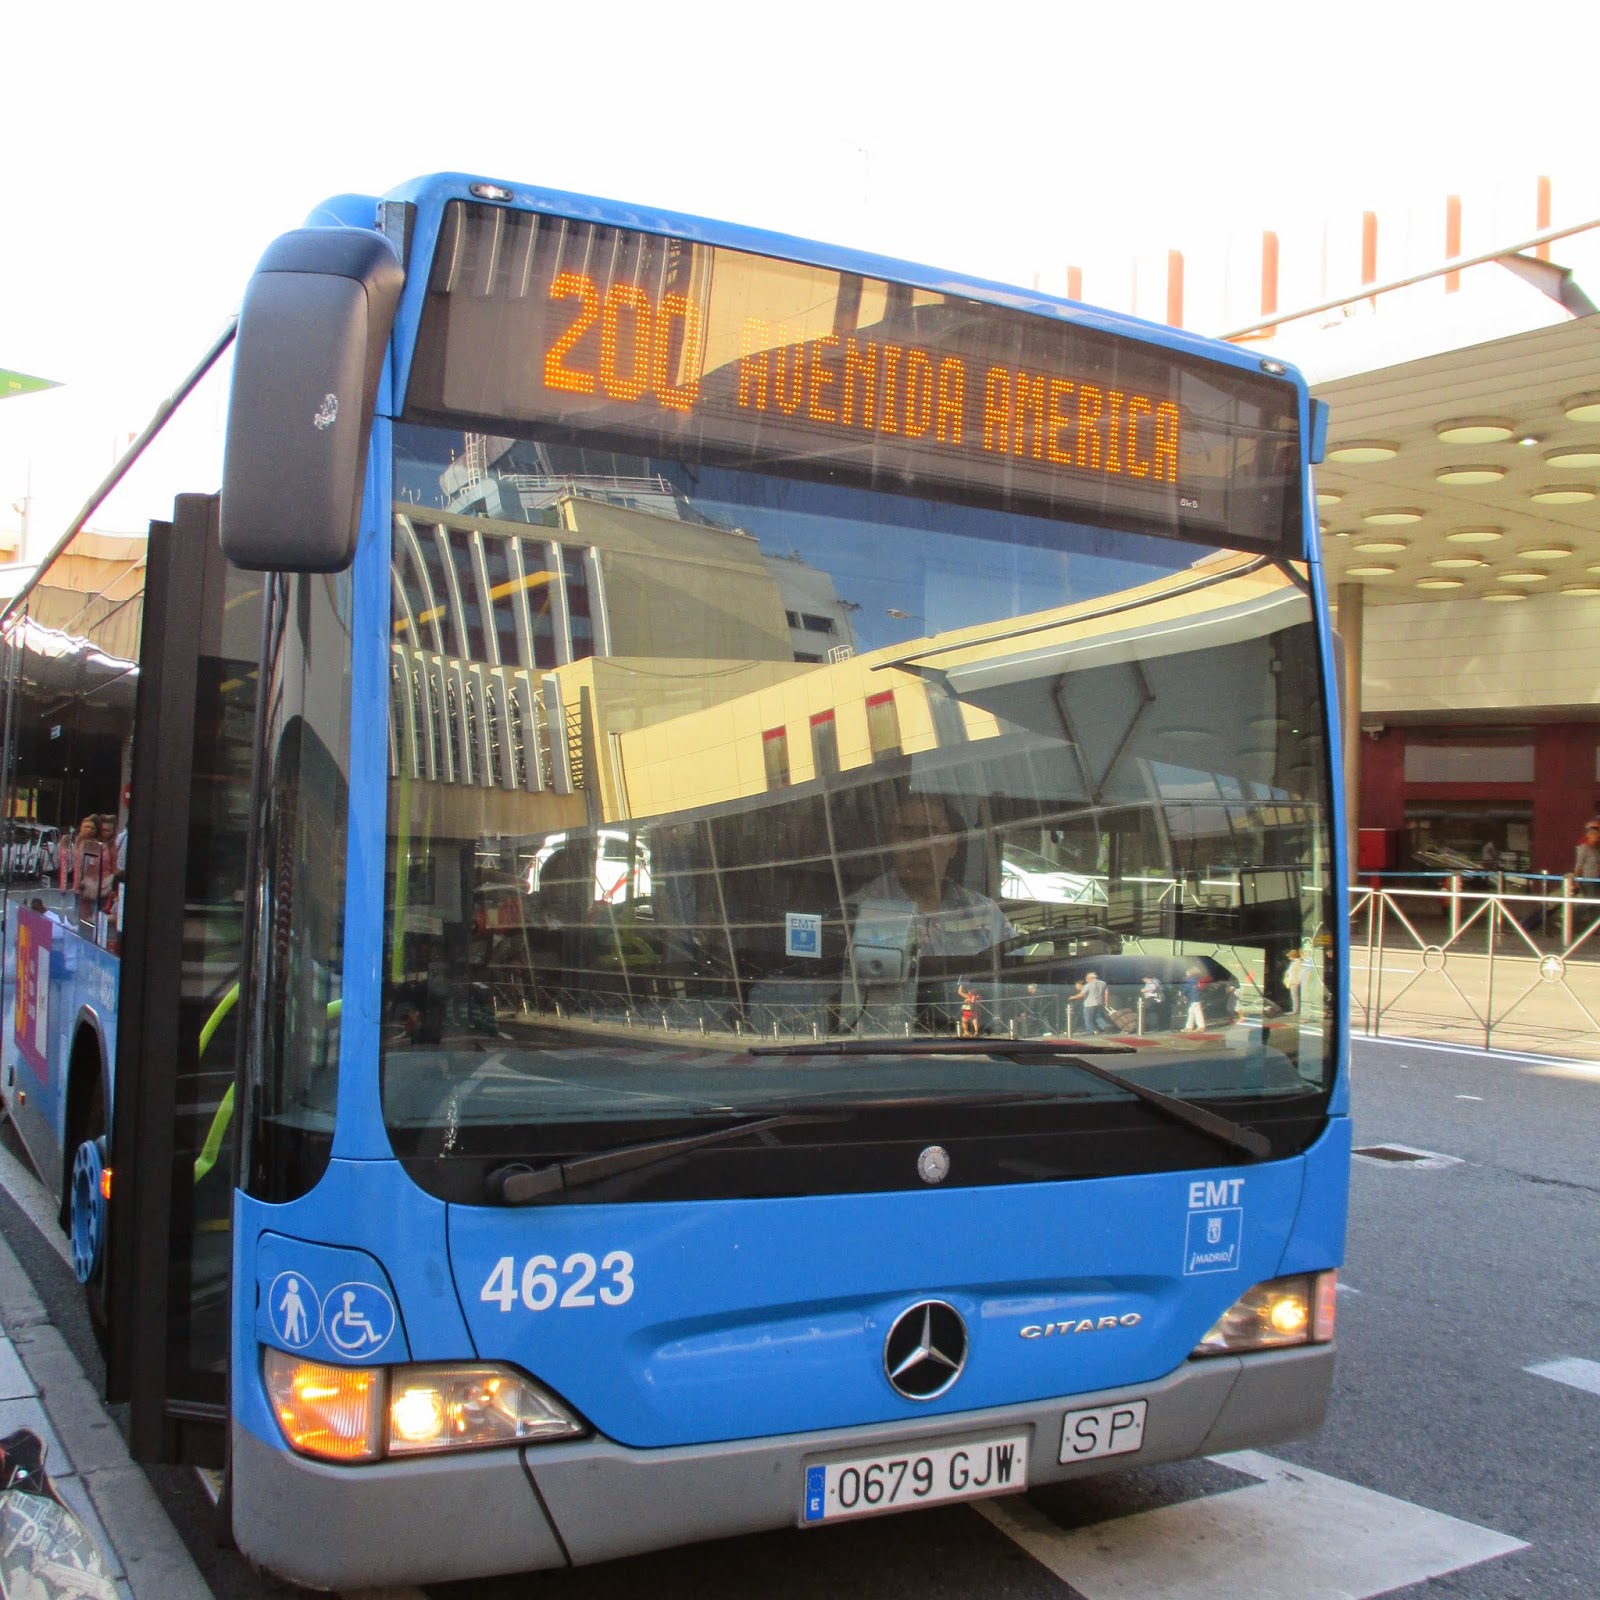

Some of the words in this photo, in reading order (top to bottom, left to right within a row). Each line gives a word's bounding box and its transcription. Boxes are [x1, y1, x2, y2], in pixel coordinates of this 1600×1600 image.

[543, 271, 701, 412] 200
[738, 316, 964, 445] AVENIDA
[984, 366, 1179, 482] AMERICA
[791, 918, 817, 929] EMT
[1188, 1178, 1245, 1209] EMT
[480, 1250, 635, 1312] 4623
[1019, 1312, 1142, 1339] CITARO
[838, 1456, 934, 1508] 0679
[949, 1444, 1016, 1490] GJW
[811, 1498, 820, 1511] E
